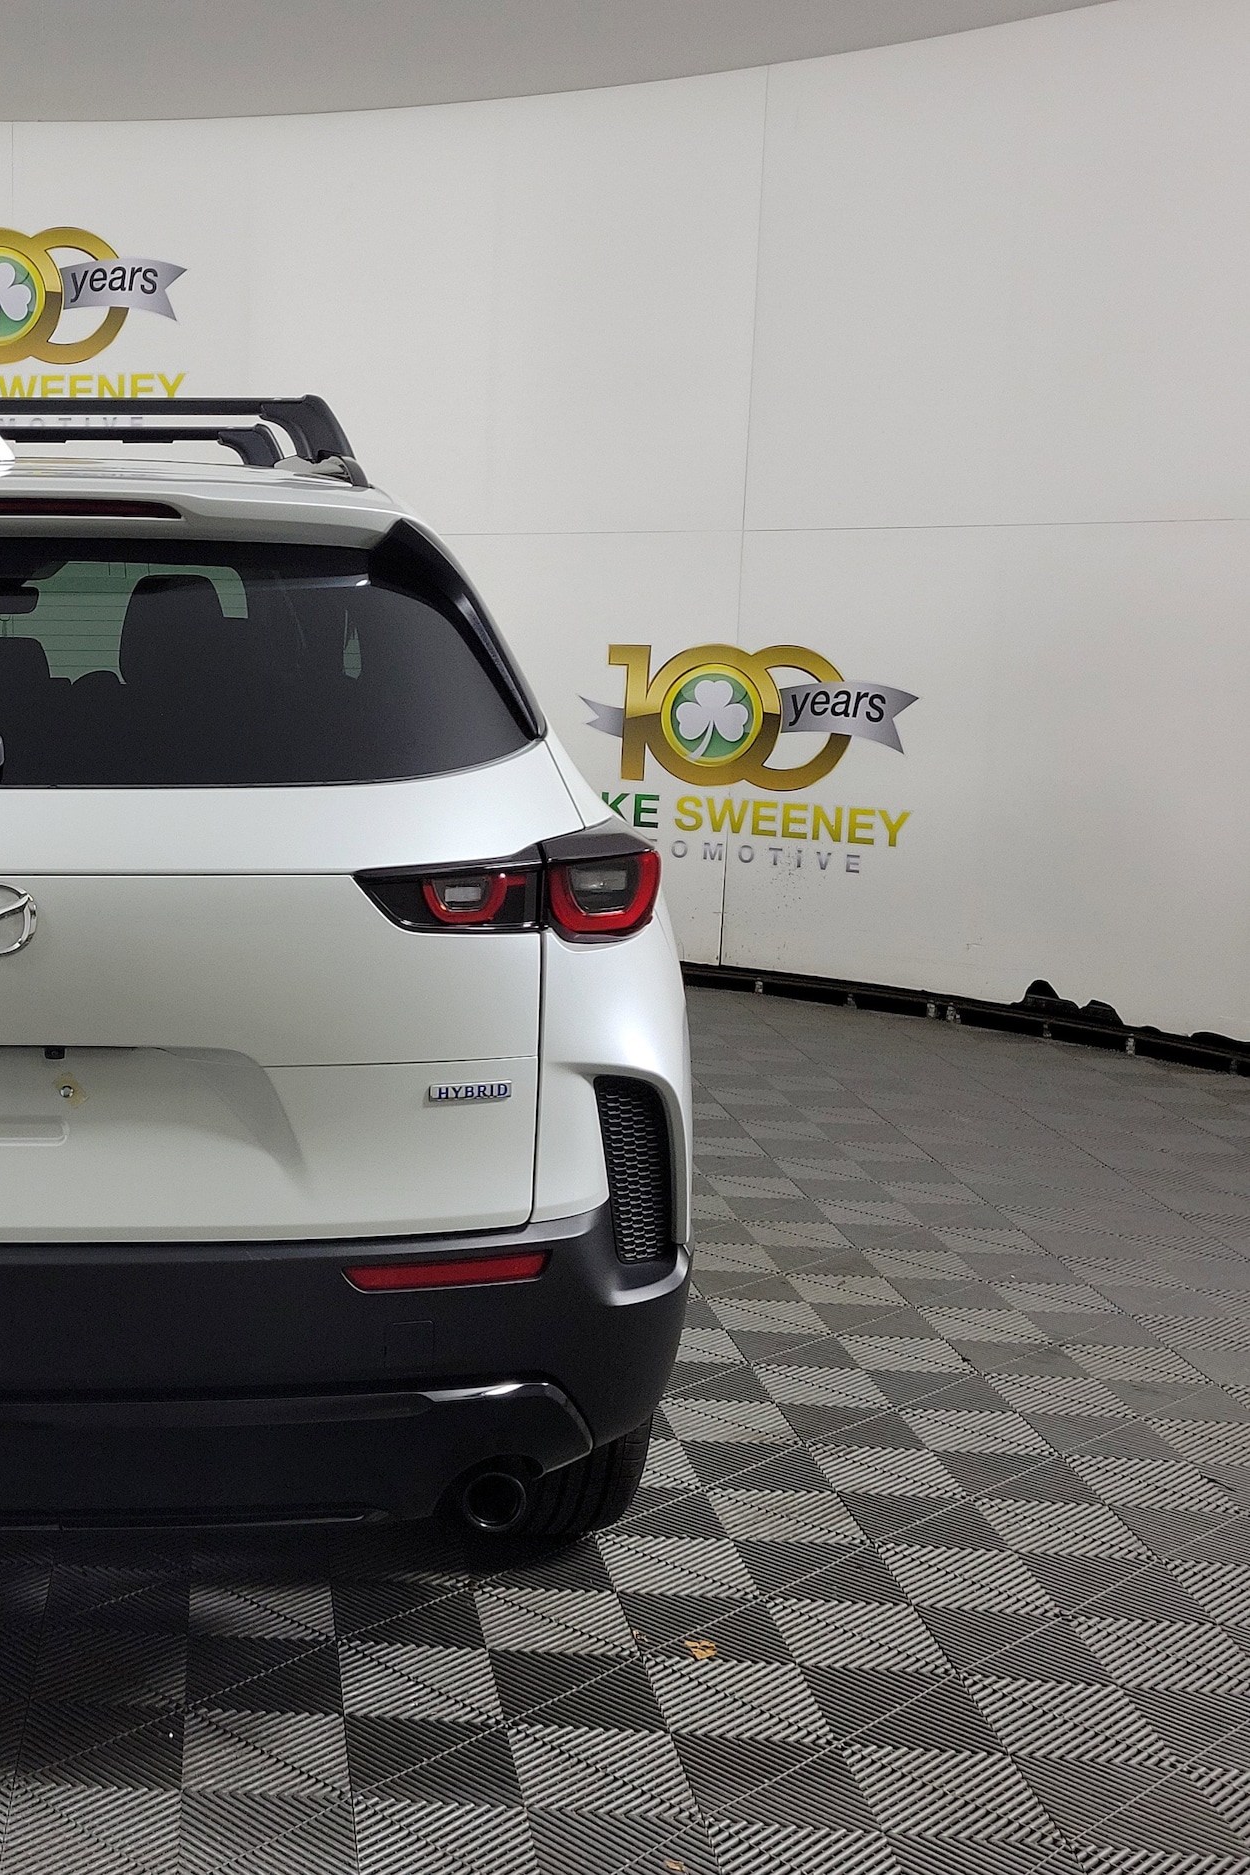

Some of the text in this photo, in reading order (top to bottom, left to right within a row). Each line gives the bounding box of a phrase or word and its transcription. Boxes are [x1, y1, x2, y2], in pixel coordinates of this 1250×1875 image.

[70, 265, 159, 303] years
[608, 643, 887, 791] 100 years
[674, 795, 911, 848] SWEENEY
[648, 838, 861, 874] OMOTIVE
[438, 1084, 508, 1100] HYBRID
